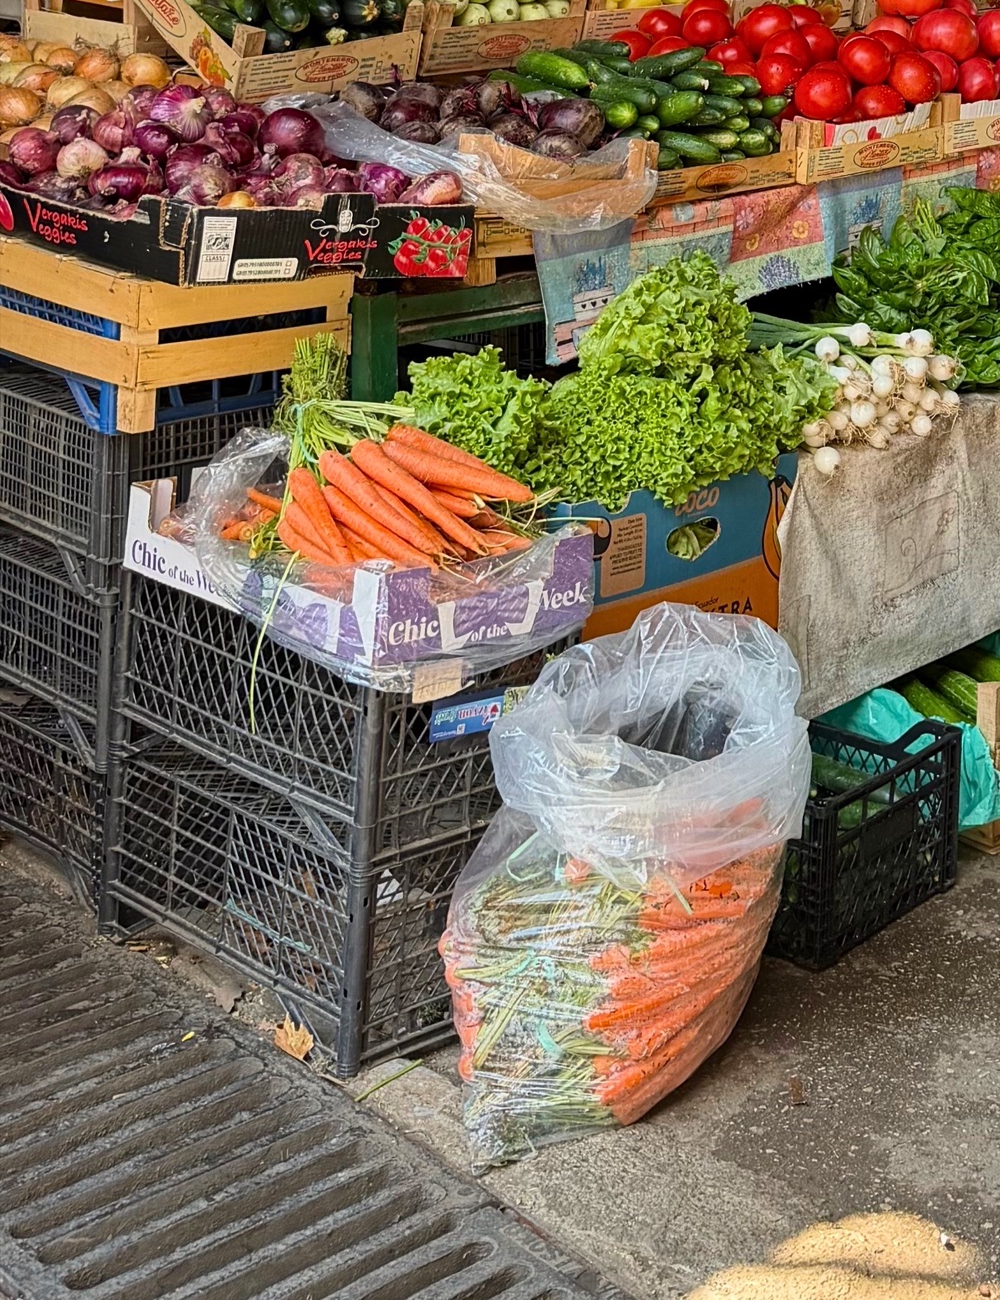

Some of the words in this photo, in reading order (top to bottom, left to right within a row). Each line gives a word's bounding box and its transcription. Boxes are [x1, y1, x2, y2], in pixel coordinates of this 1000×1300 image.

[302, 56, 355, 71] MONTENEGRO
[23, 197, 88, 232] Vergakis
[132, 539, 166, 575] Chic
[168, 565, 179, 579] of
[179, 571, 195, 587] the
[388, 616, 440, 647] Chic
[470, 625, 485, 642] of
[486, 621, 508, 638] the
